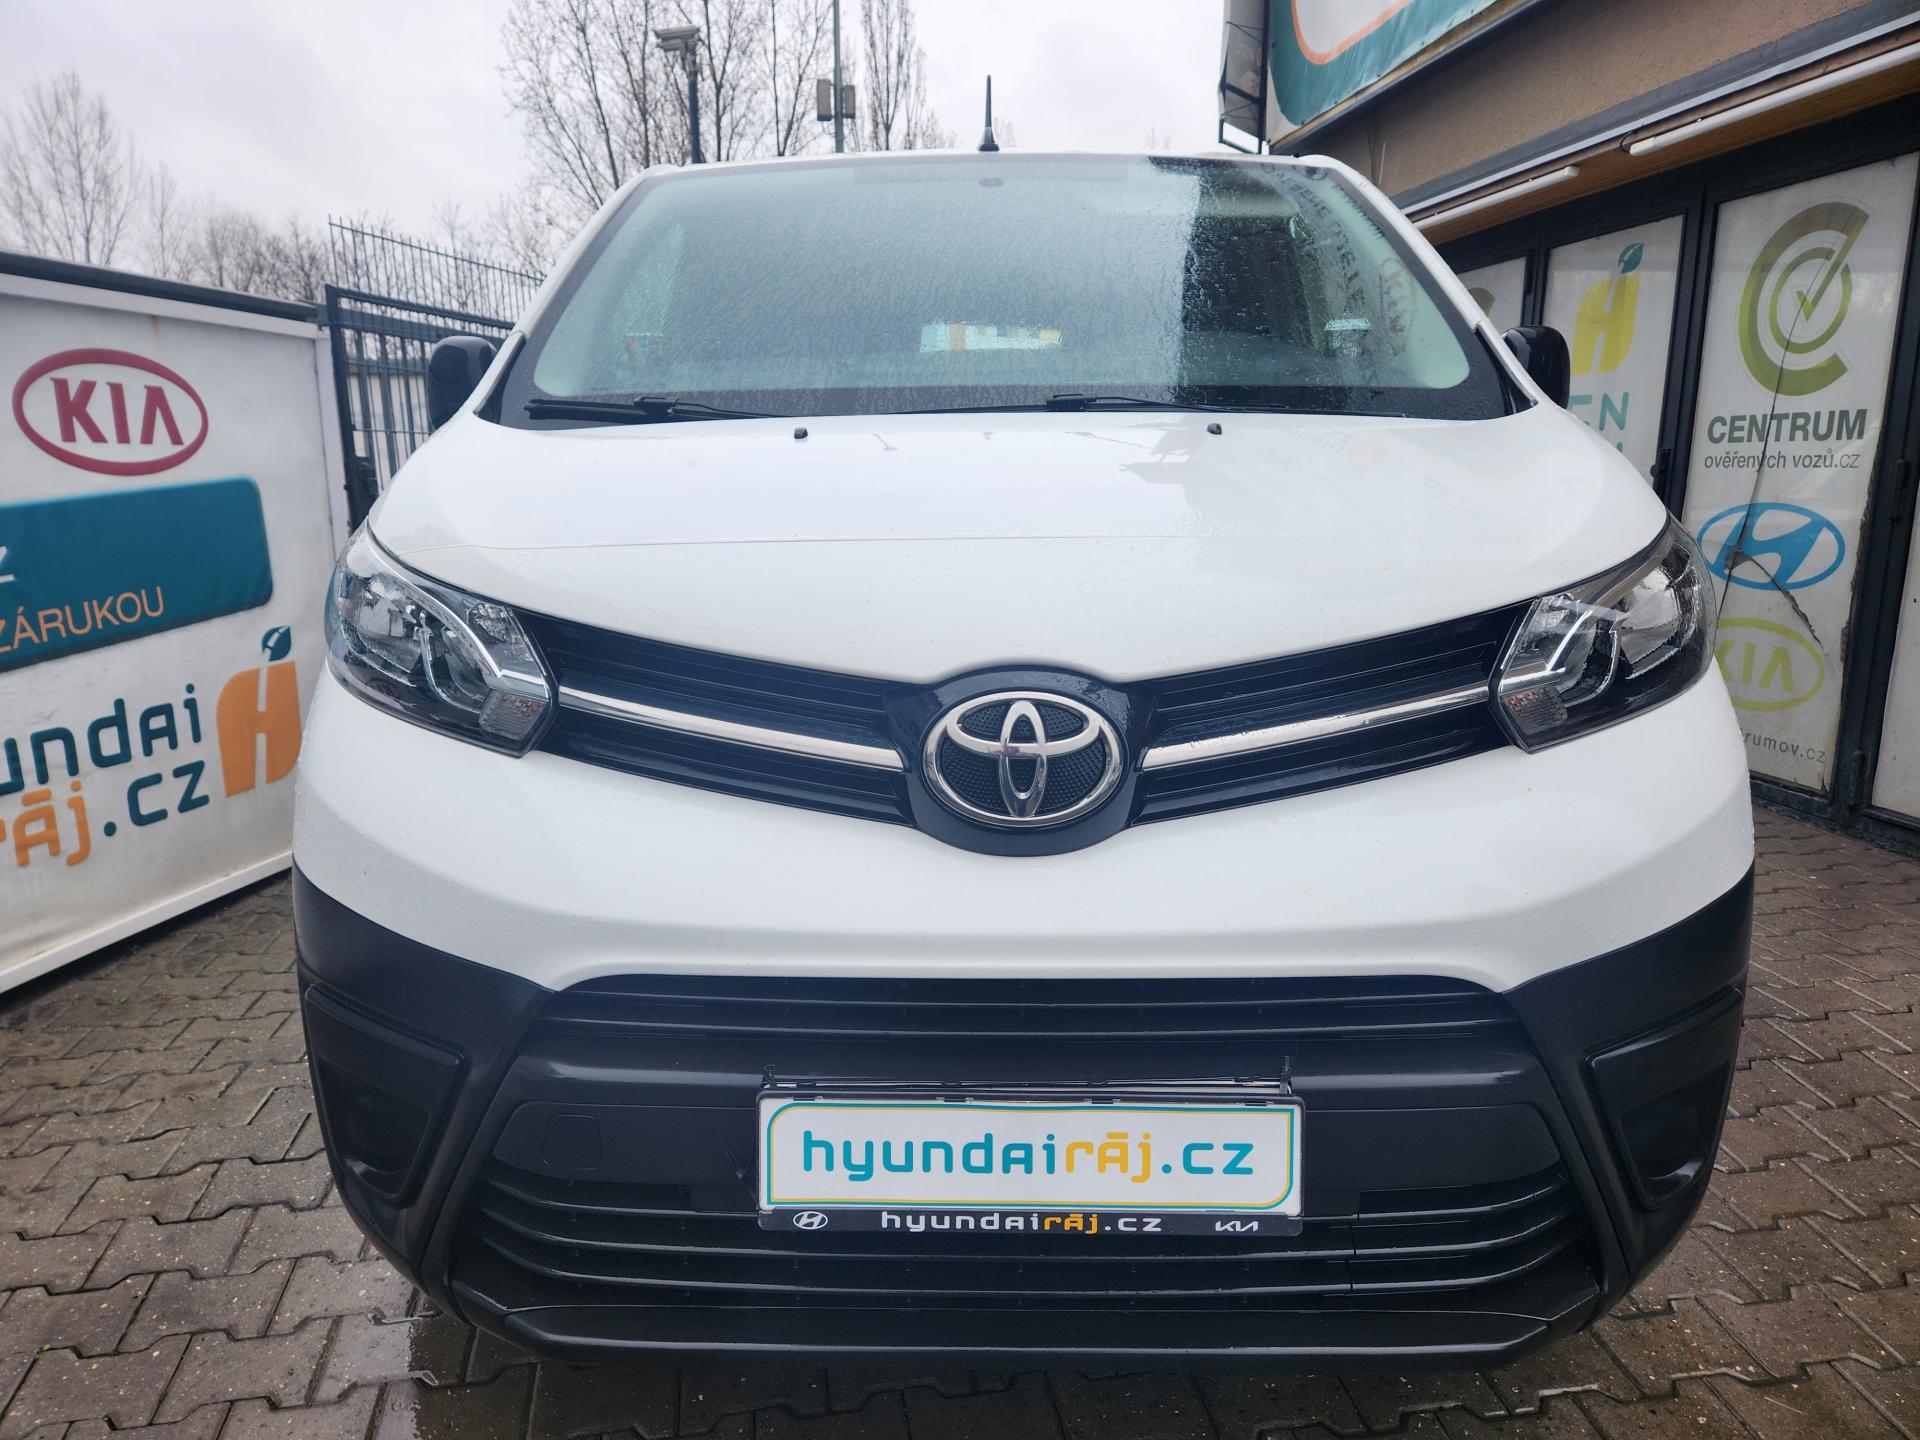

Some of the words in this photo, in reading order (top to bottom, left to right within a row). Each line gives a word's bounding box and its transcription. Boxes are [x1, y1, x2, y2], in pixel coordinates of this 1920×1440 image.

[50, 376, 184, 445] KIA
[1707, 408, 1868, 445] CENTRUM
[1740, 727, 1826, 764] rumov.cz
